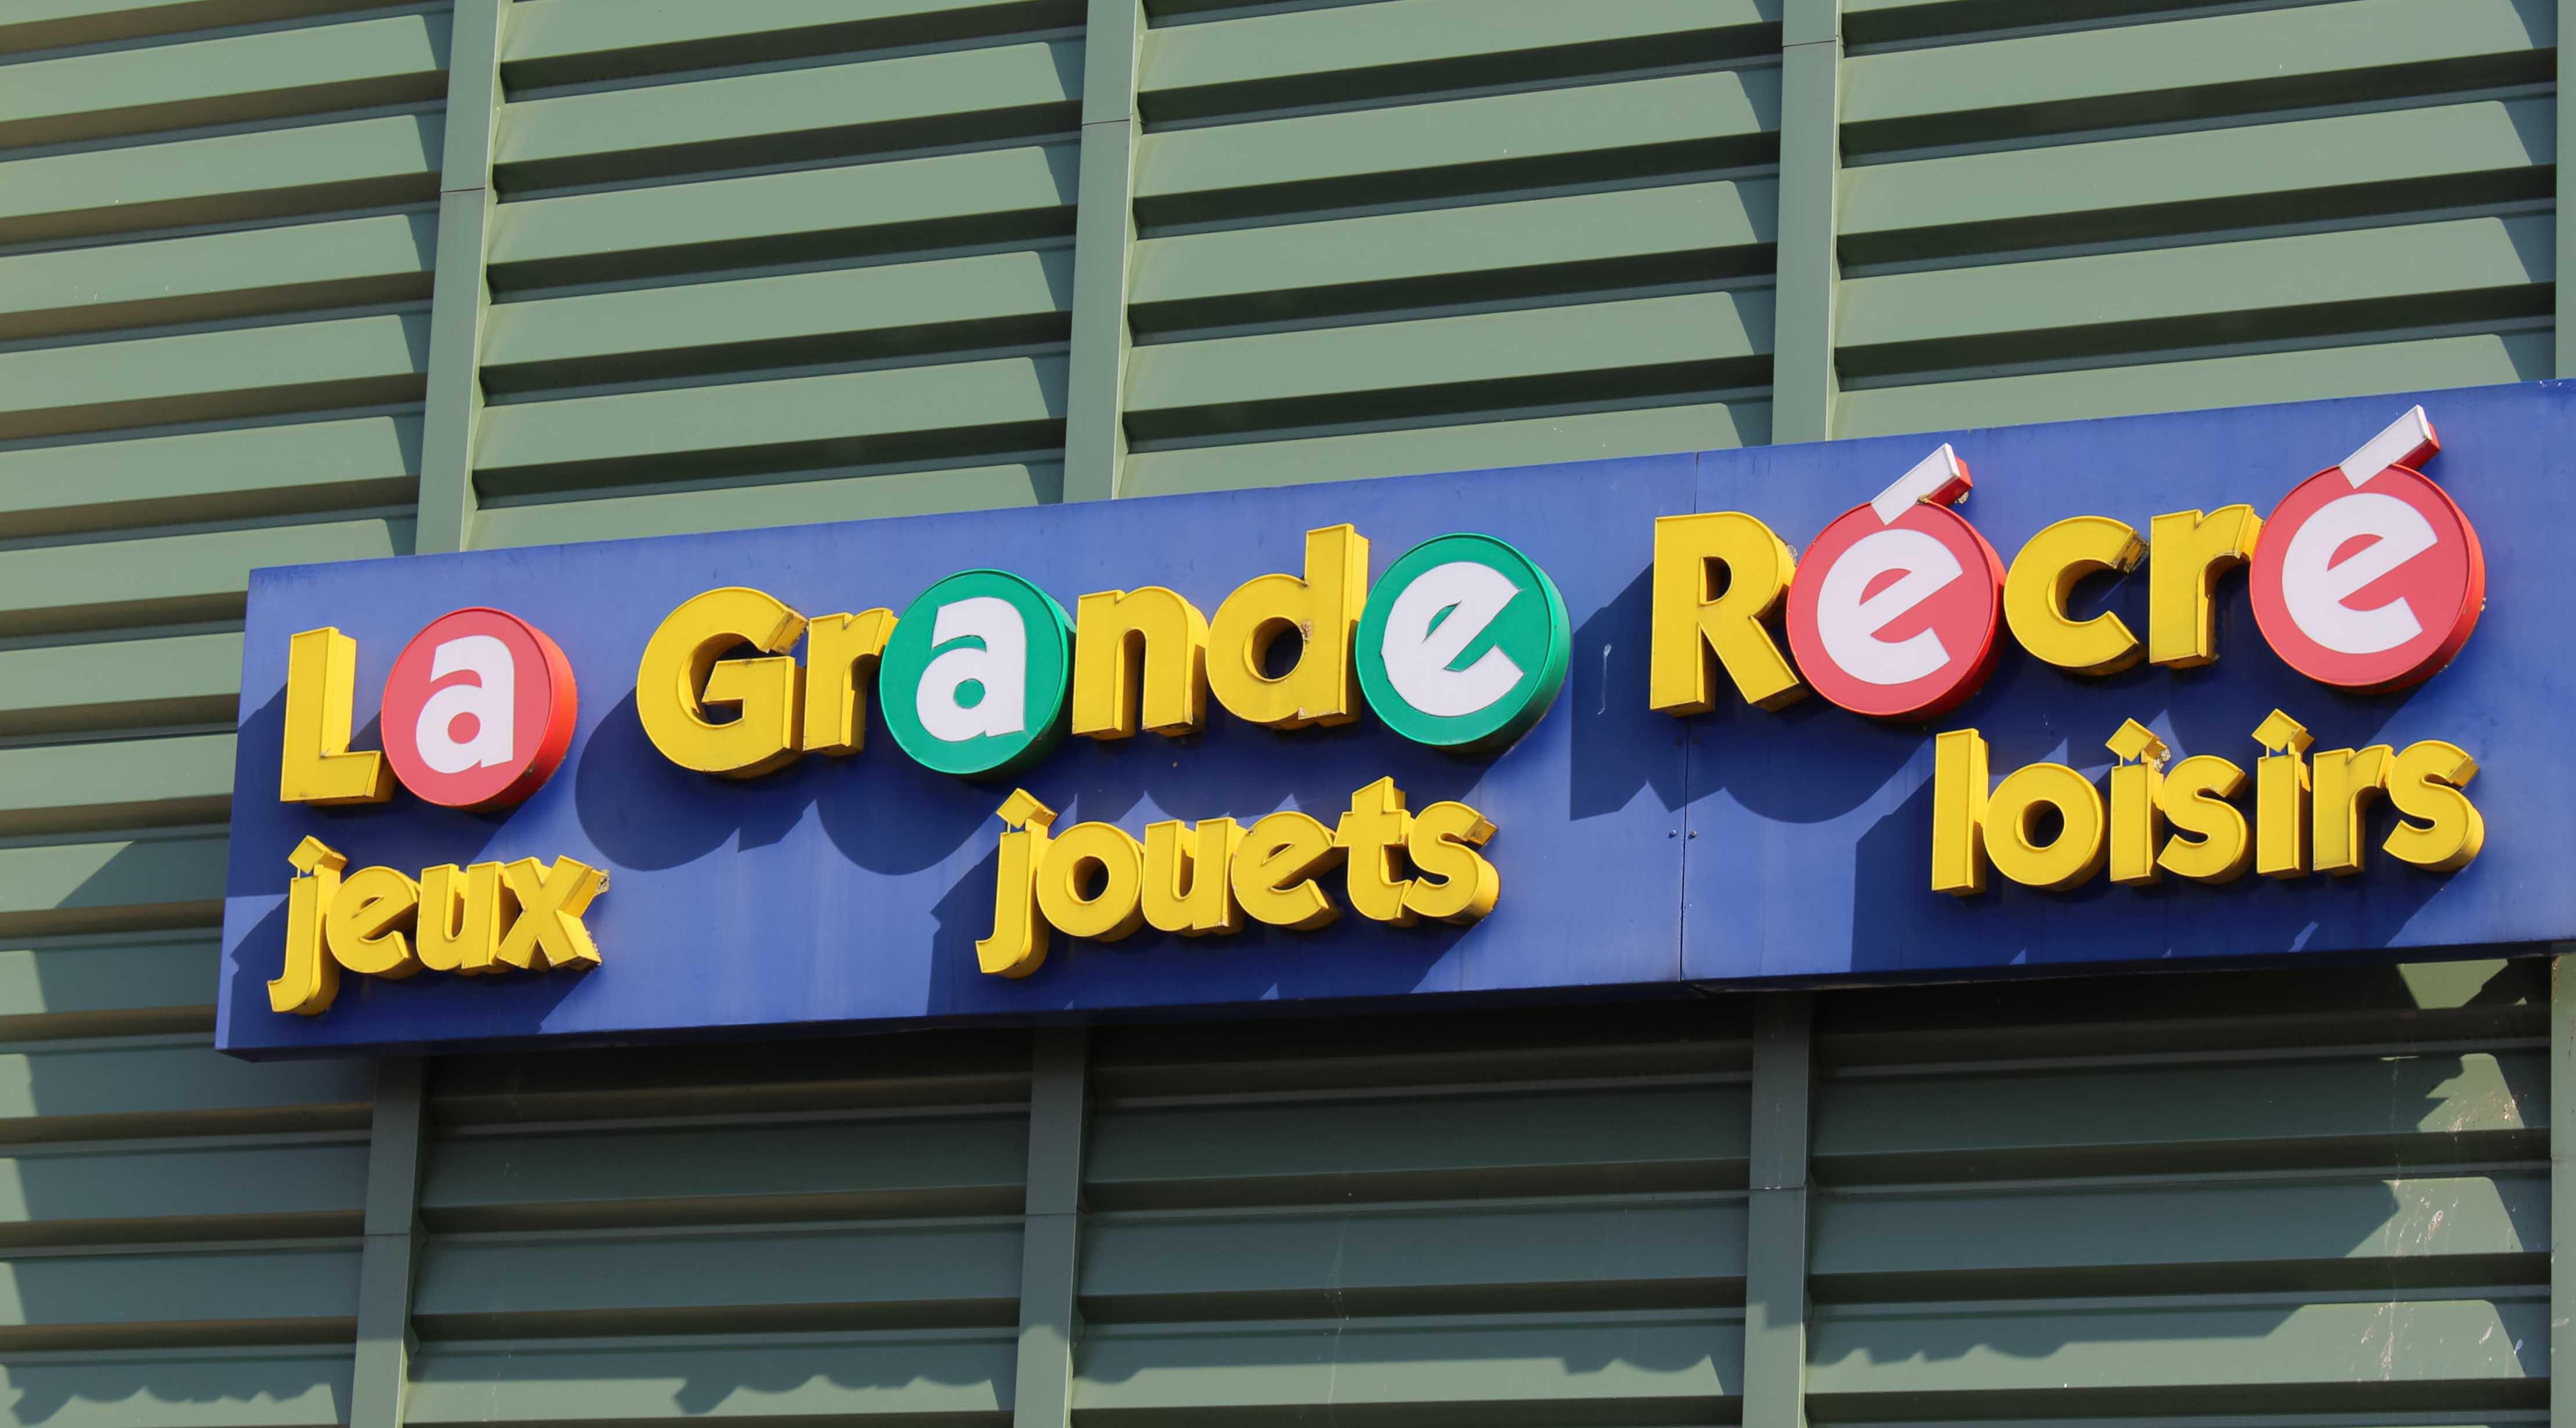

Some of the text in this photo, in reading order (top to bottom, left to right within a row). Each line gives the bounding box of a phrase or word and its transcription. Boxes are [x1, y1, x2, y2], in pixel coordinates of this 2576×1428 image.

[280, 404, 2484, 808] La Grande Récré
[267, 708, 2485, 1015] jeux jouets loisirs
